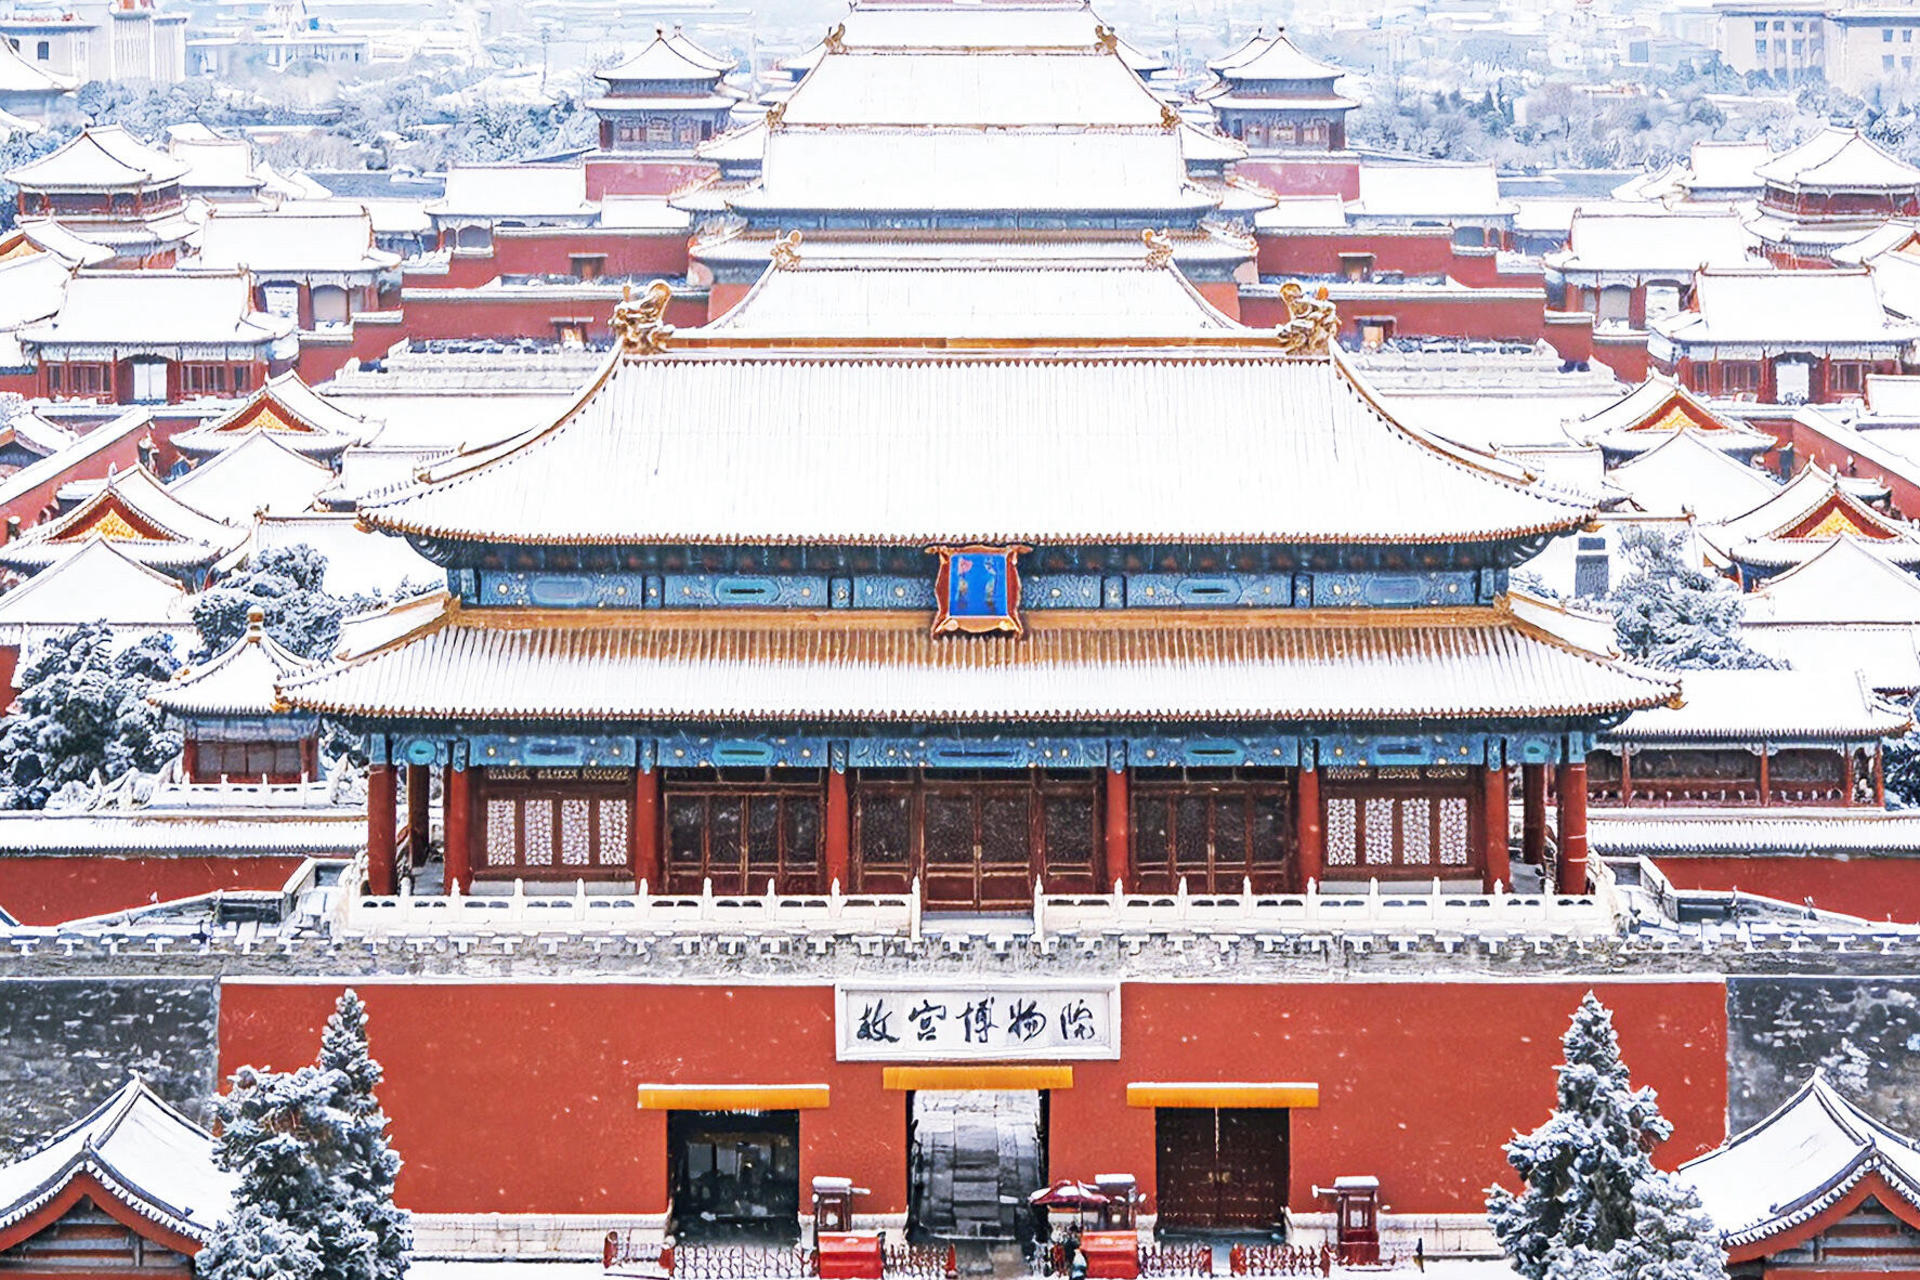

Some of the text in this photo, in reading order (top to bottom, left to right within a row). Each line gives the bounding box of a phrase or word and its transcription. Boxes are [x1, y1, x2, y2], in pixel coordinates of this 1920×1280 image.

[856, 996, 1096, 1043] 故宫博物院
